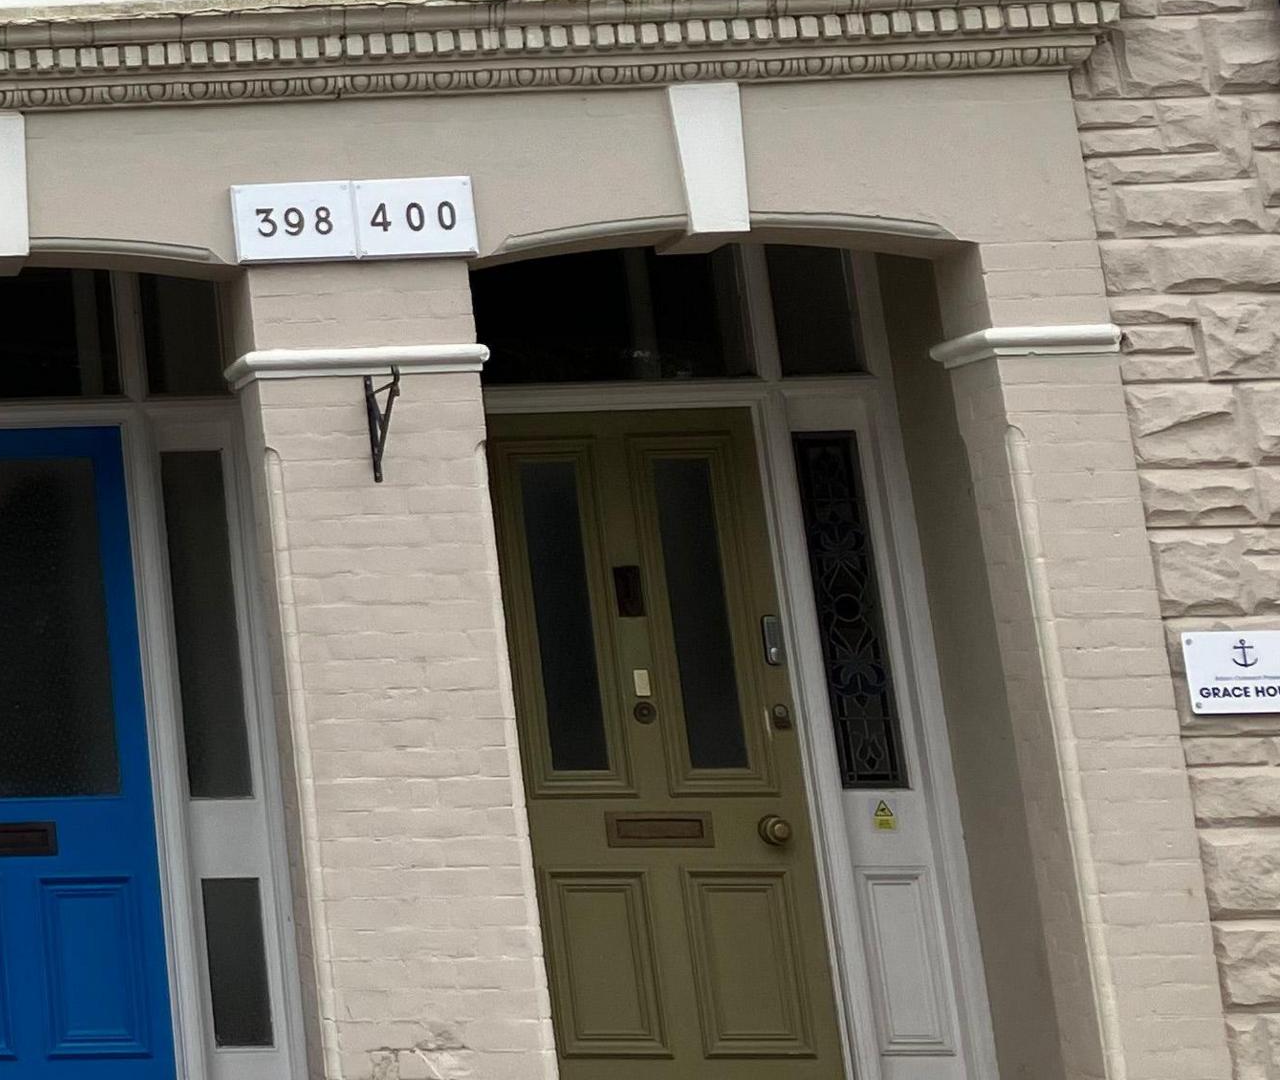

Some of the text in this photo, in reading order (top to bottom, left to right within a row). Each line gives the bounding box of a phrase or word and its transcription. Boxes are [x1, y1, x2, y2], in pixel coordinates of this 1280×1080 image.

[255, 200, 456, 237] 398 400
[1199, 686, 1251, 698] GRACE
